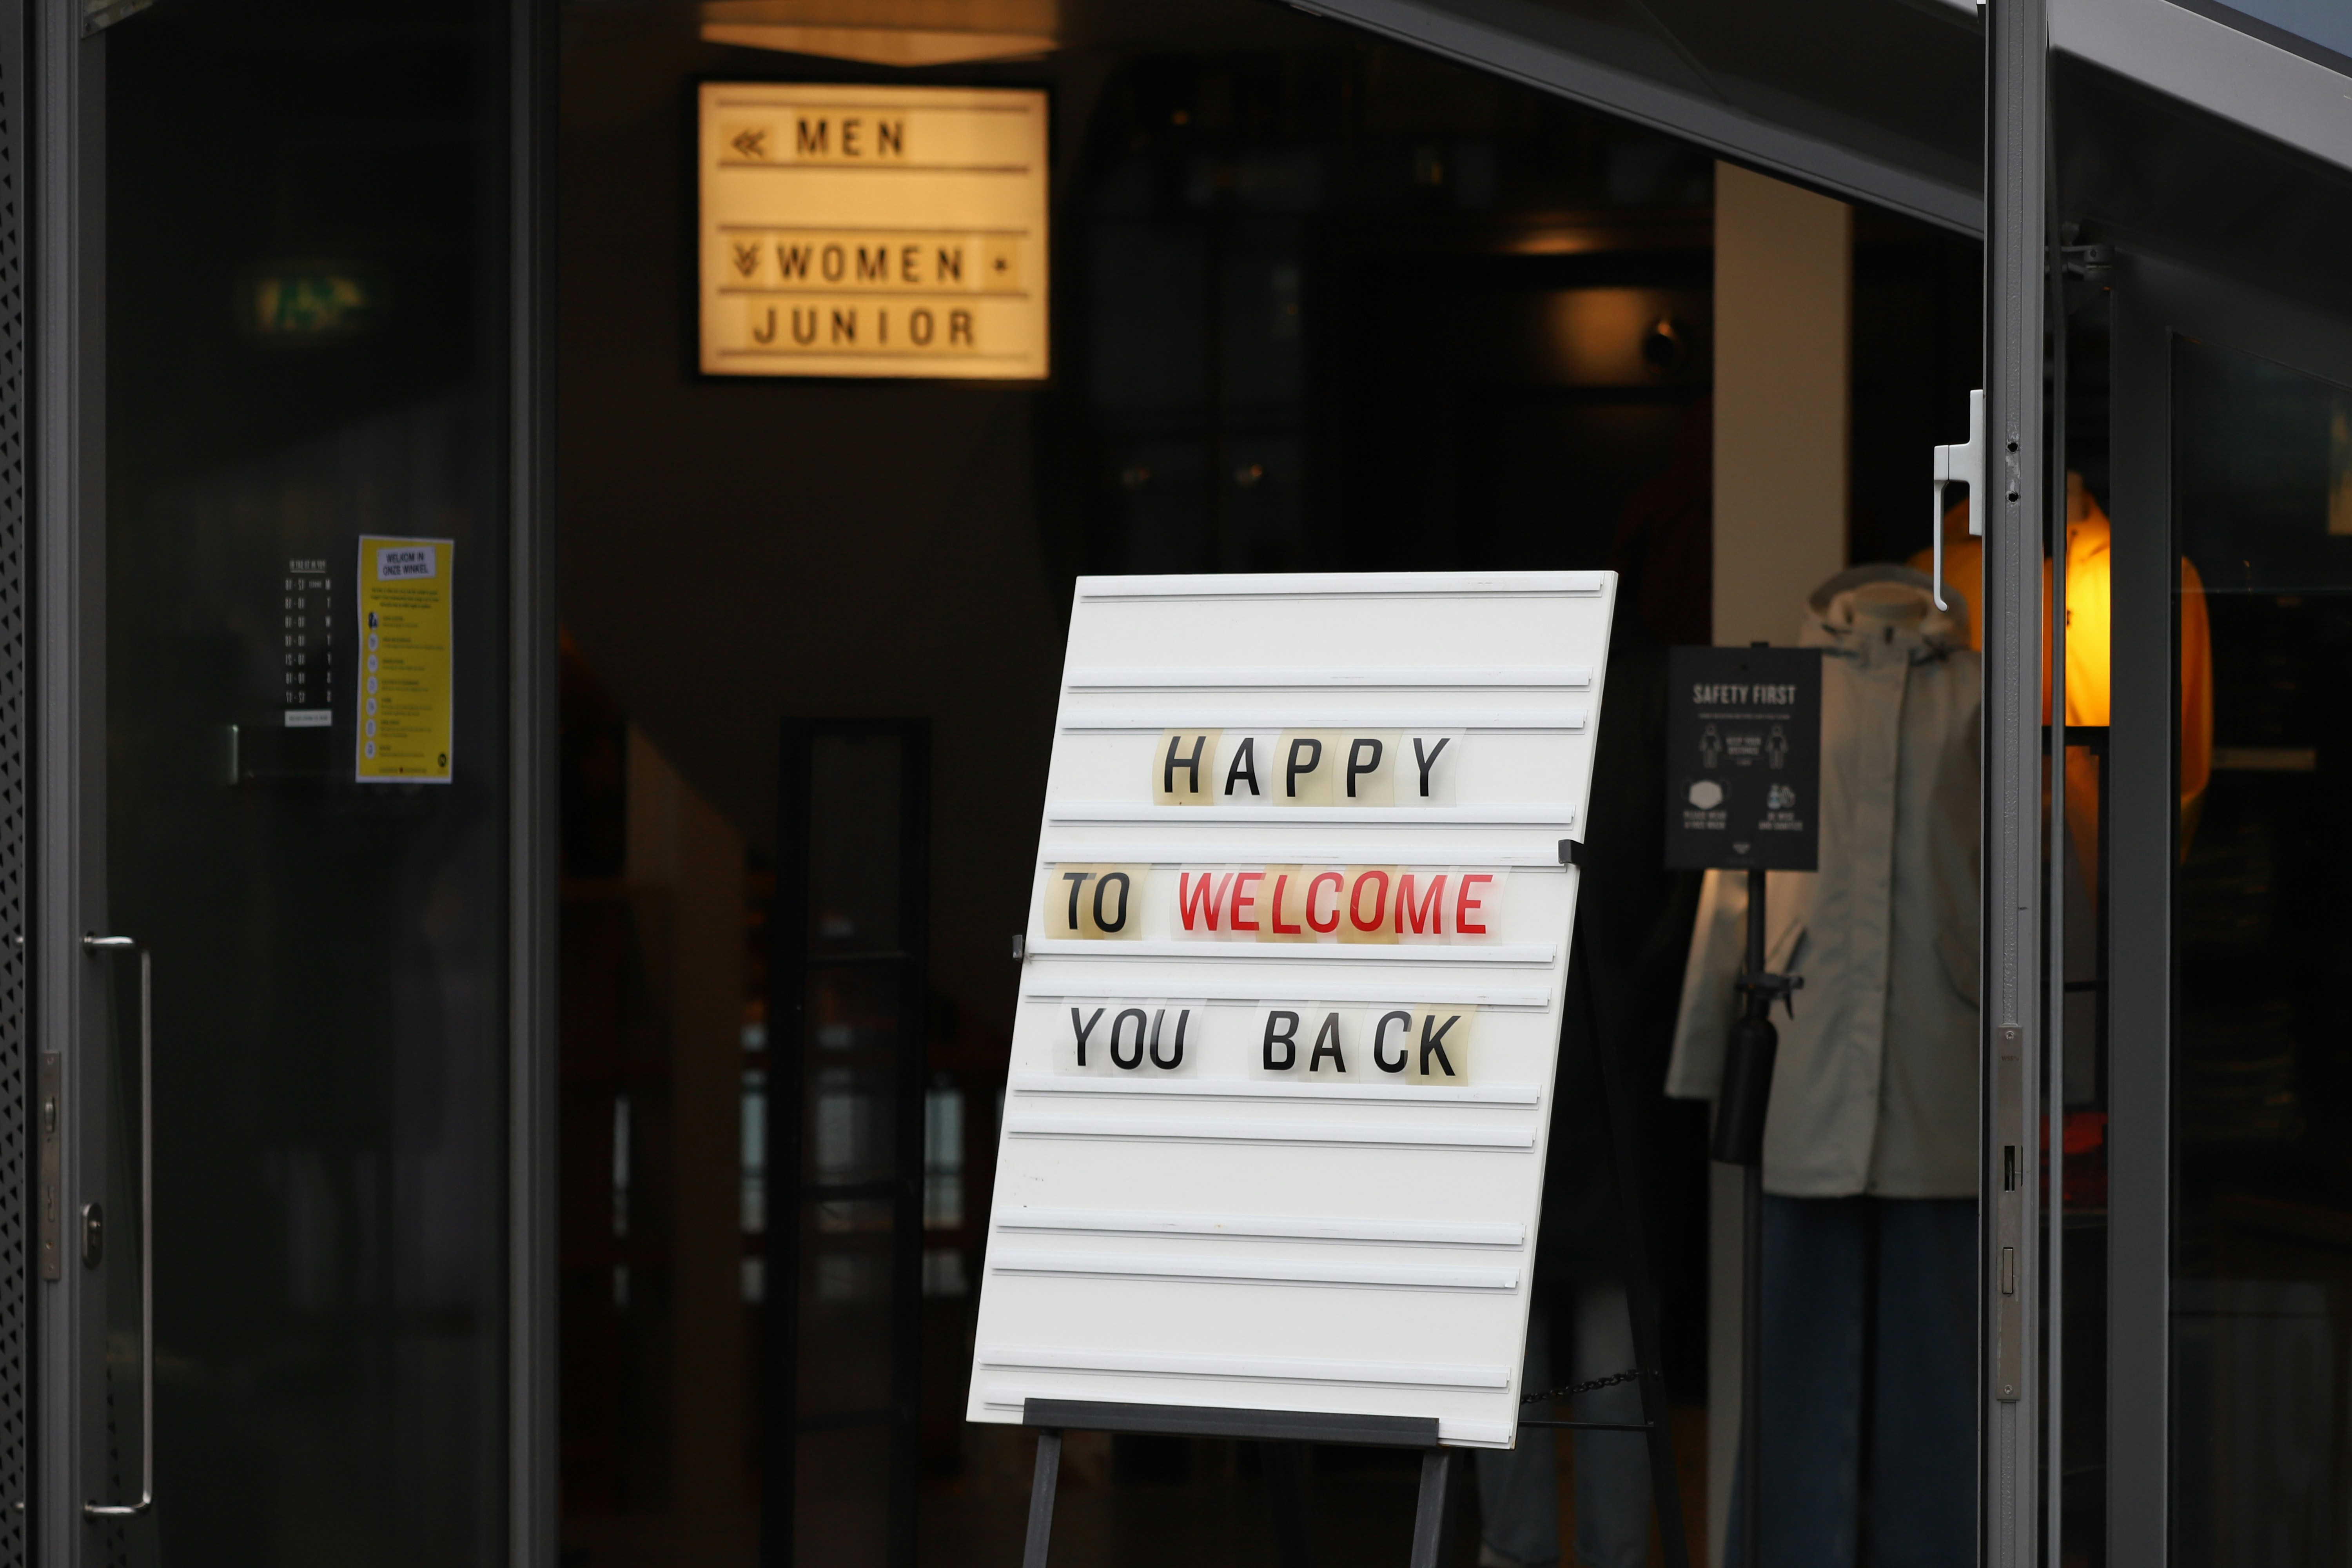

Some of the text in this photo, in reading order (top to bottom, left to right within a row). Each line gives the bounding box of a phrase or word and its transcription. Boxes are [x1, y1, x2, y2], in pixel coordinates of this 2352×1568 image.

[796, 118, 903, 156] MEN
[777, 244, 962, 283] WOMEN
[752, 307, 975, 347] JUNIOR
[383, 563, 428, 575] ONZE WINKEL
[386, 552, 425, 563] WELKOM IN
[1693, 684, 1796, 705] SAFETY FIRST
[1163, 736, 1451, 798] HAPPY
[1062, 870, 1493, 935] TO WELCOME
[1071, 1007, 1461, 1076] YOU BACK
